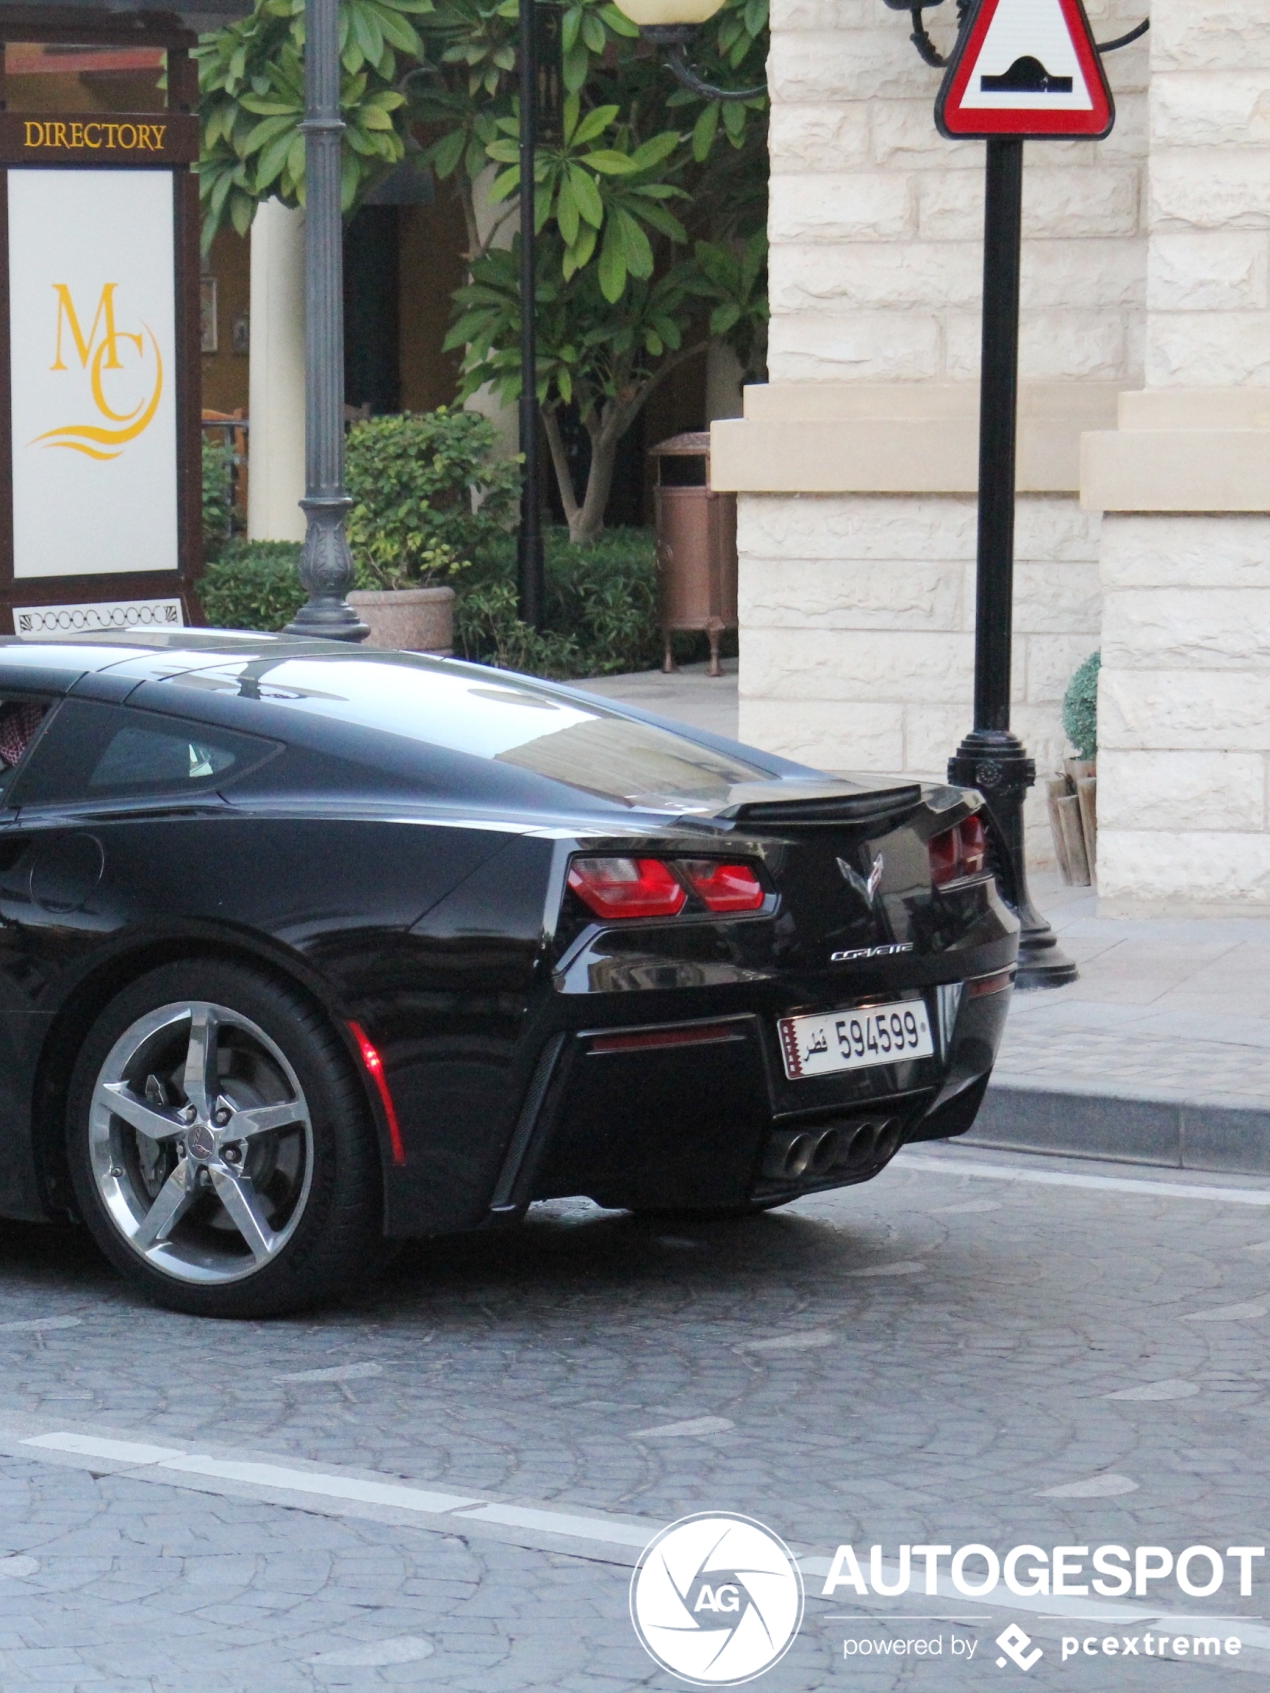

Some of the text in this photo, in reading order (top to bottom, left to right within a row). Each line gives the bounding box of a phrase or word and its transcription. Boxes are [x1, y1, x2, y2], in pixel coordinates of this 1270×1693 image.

[24, 121, 167, 150] DIRECTORY
[831, 942, 913, 961] CORVETTE
[803, 1011, 919, 1062] قطر 594599
